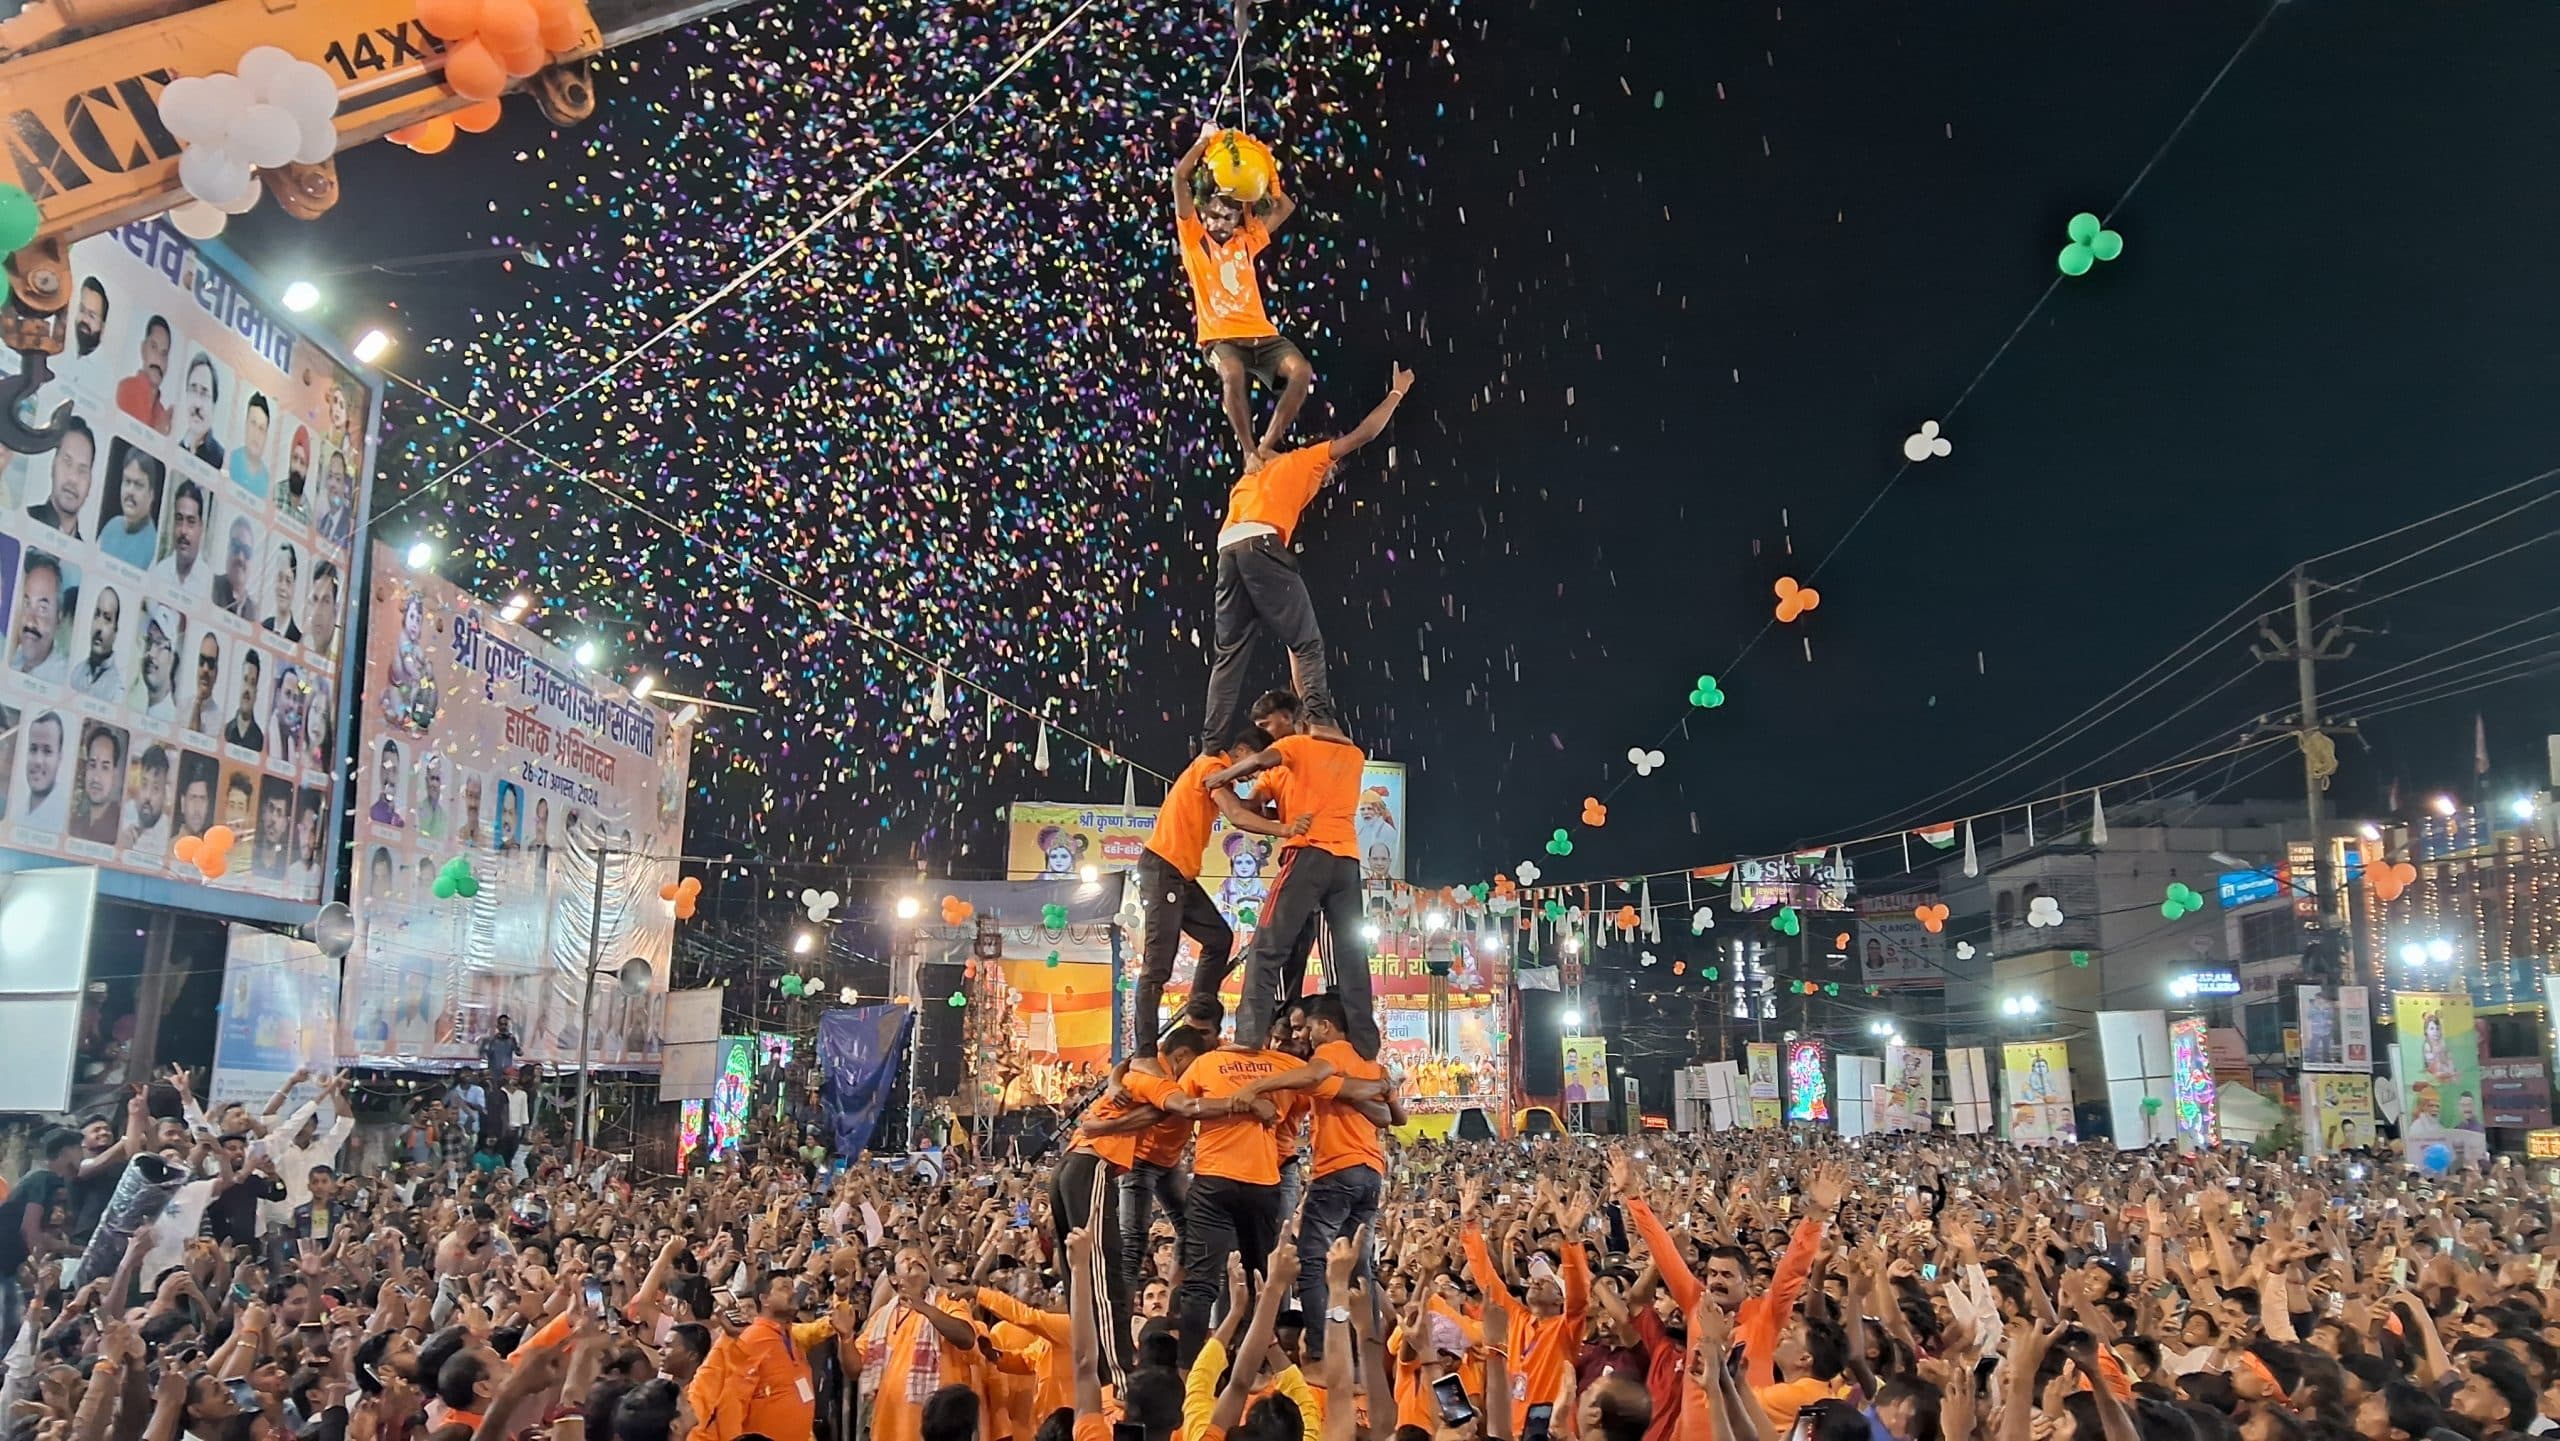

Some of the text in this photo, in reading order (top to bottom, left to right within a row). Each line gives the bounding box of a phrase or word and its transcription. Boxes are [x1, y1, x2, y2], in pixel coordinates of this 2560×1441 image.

[452, 608, 481, 671] श्री
[484, 630, 528, 700] कृष्ण
[609, 699, 655, 757] समिति
[505, 704, 552, 757] हार्दिक
[1080, 812, 1094, 827] श्री
[1096, 815, 1124, 832] कृष्ण
